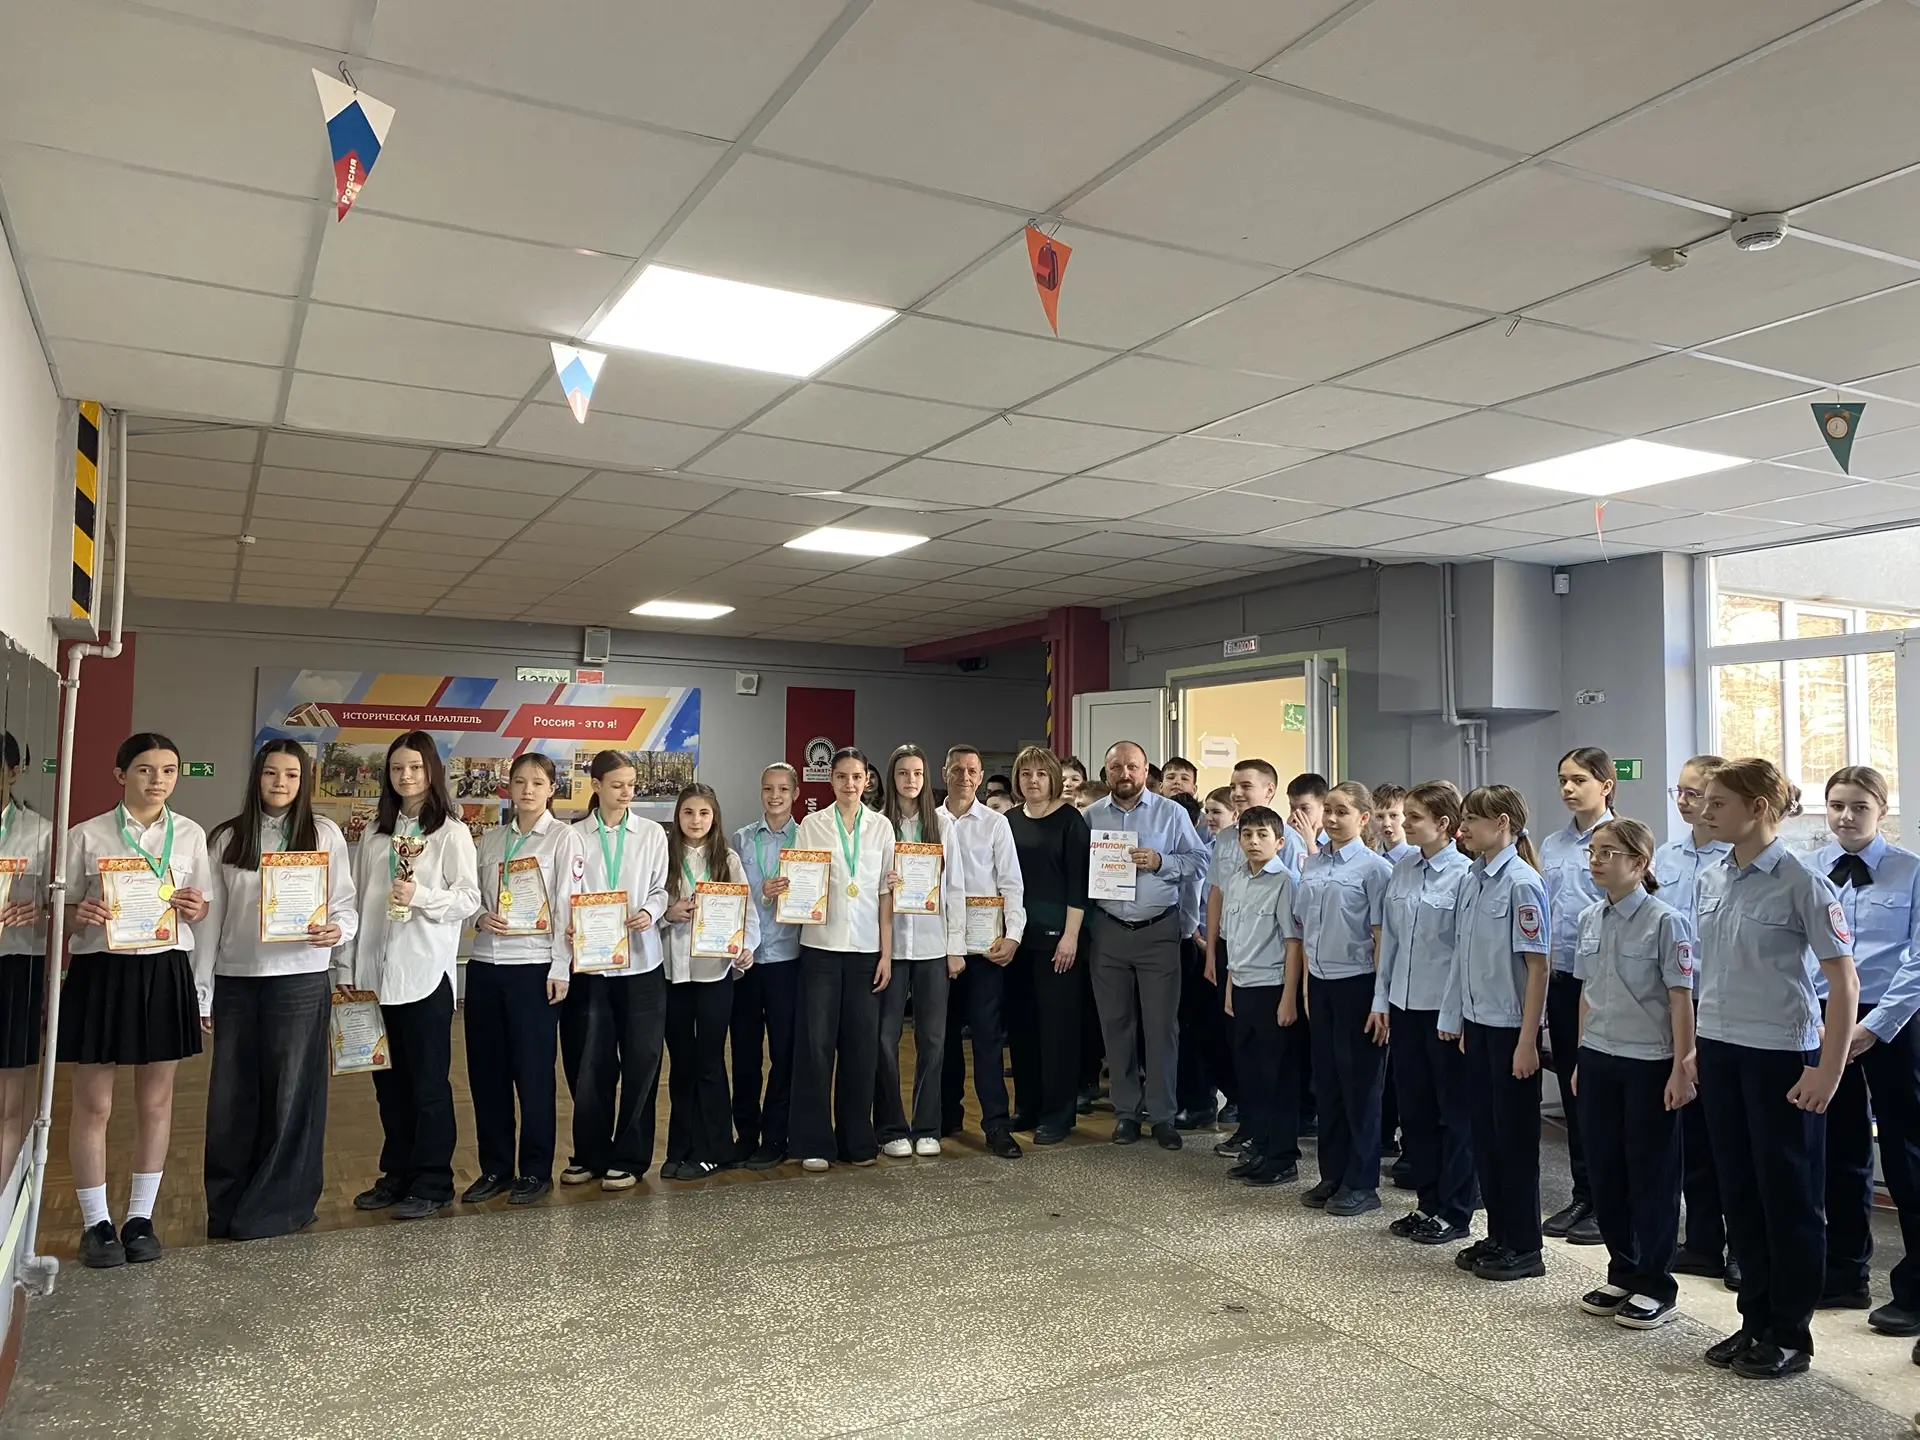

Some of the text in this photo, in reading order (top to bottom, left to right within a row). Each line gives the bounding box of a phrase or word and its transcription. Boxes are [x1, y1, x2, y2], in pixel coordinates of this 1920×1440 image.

[1228, 640, 1256, 653] ВЫХОД
[342, 712, 482, 724] ИСТОРИЧЕСКАЯ ПАРАЛЛЕЛЬ
[533, 716, 575, 727] Россия
[585, 720, 604, 728] это
[607, 719, 617, 729] я!
[1091, 842, 1126, 850] ДИПЛОМ
